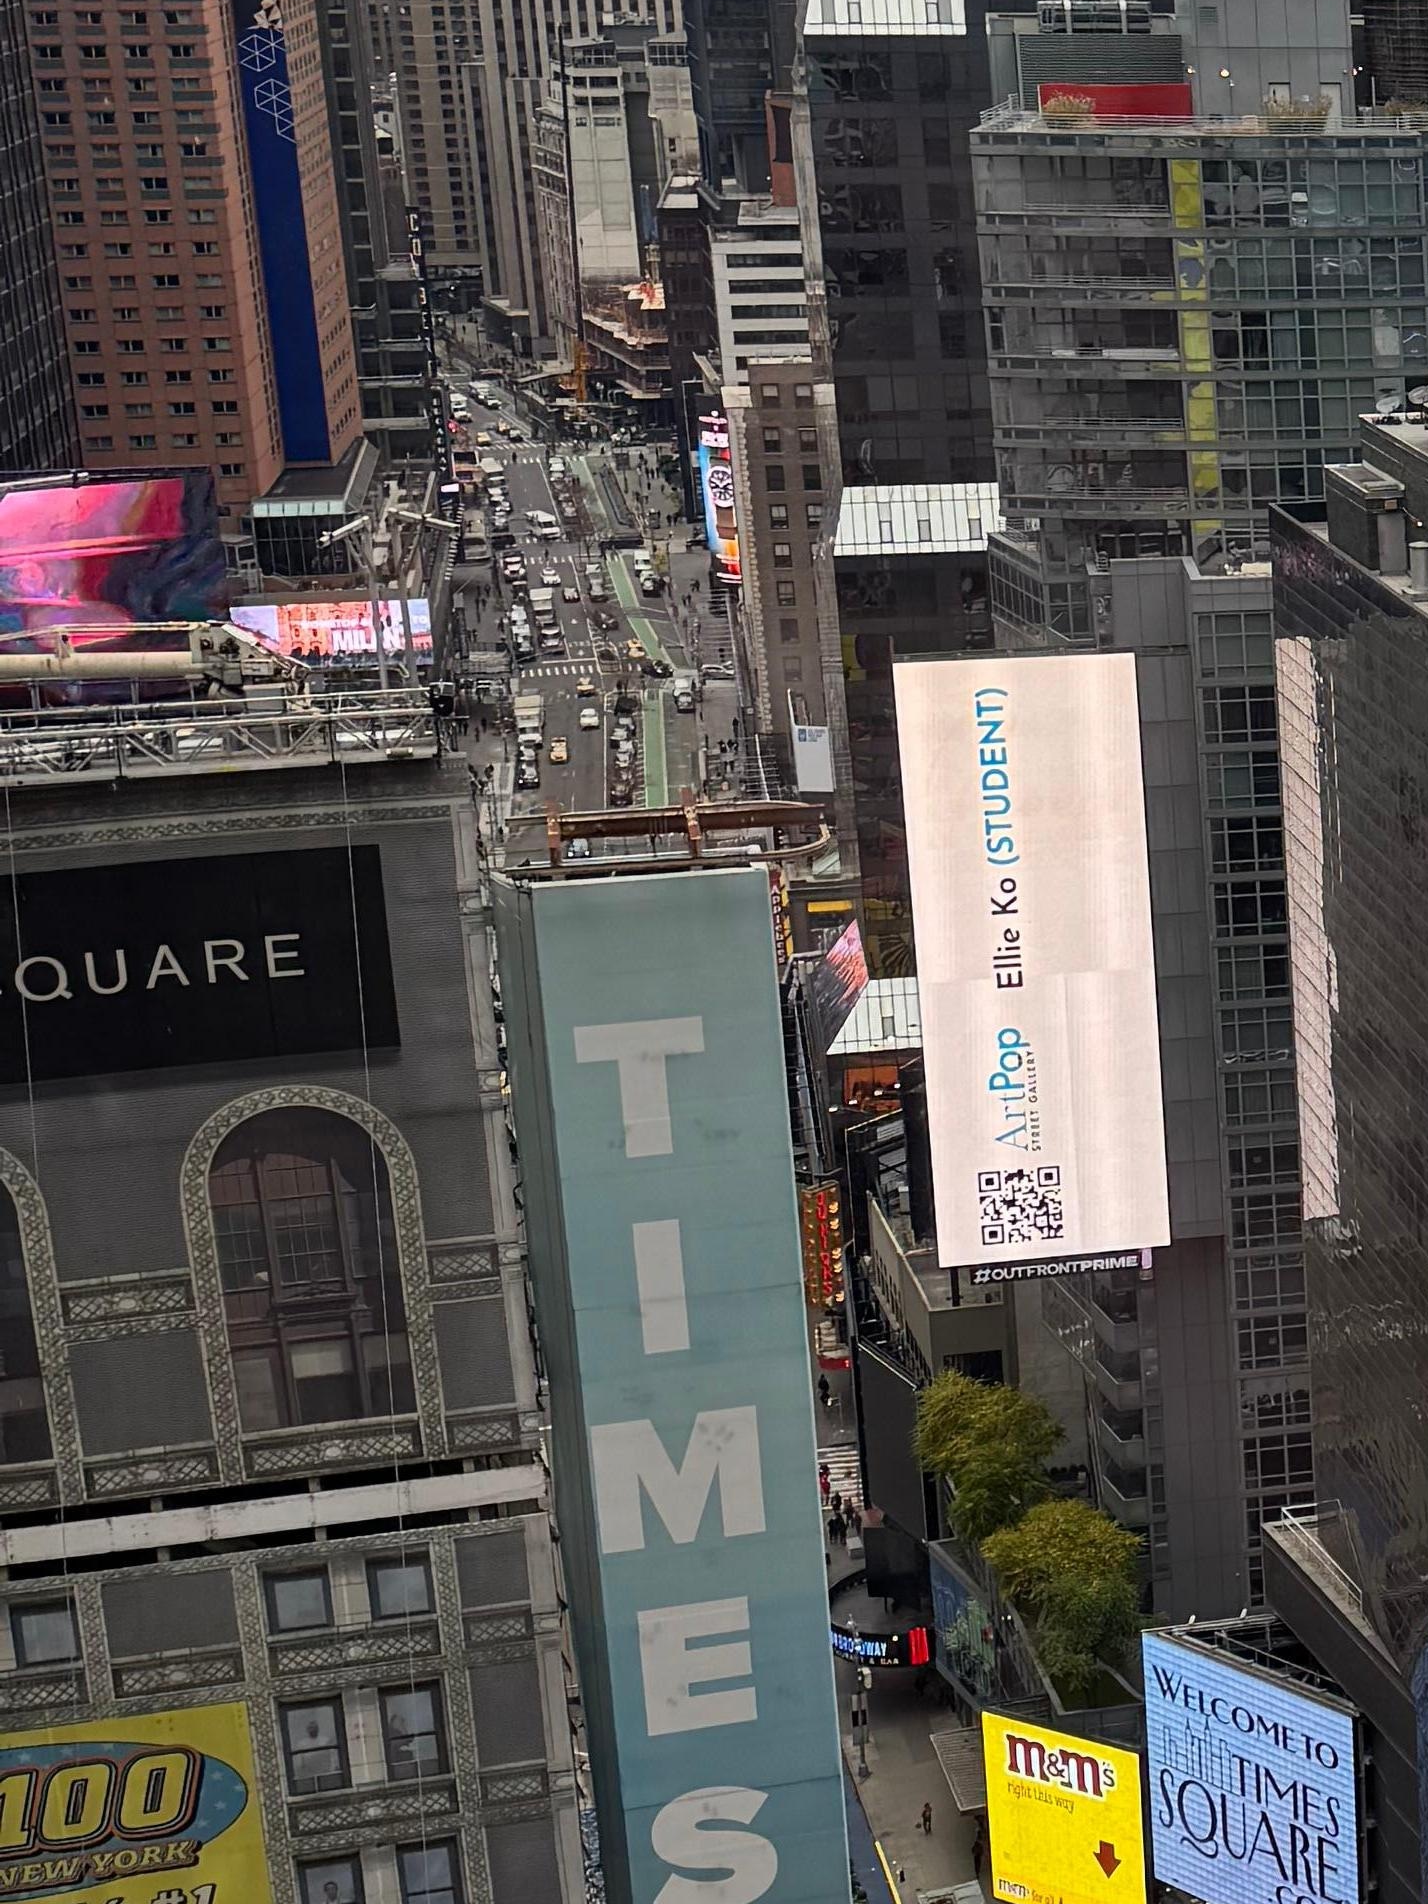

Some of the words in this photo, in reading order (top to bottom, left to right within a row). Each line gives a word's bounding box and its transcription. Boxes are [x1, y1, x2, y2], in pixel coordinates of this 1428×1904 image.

[974, 687, 1020, 865] (STUDENT)
[990, 877, 1019, 916] Ko
[0, 933, 306, 1003] QUARE
[993, 928, 1023, 988] Ellie
[988, 1027, 1031, 1151] ArtPop
[1026, 1050, 1039, 1103] GALLERY
[1030, 1110, 1042, 1152] STREET
[1152, 1663, 1298, 1752] WELCOME
[1300, 1732, 1340, 1769] TO
[1007, 1780, 1032, 1802] right
[1033, 1783, 1053, 1806] this
[1053, 1793, 1075, 1814] way
[1233, 1754, 1341, 1838] TIMES
[0, 1856, 81, 1891] NEW
[91, 1840, 197, 1876] YORK
[1158, 1768, 1343, 1904] SQUARE
